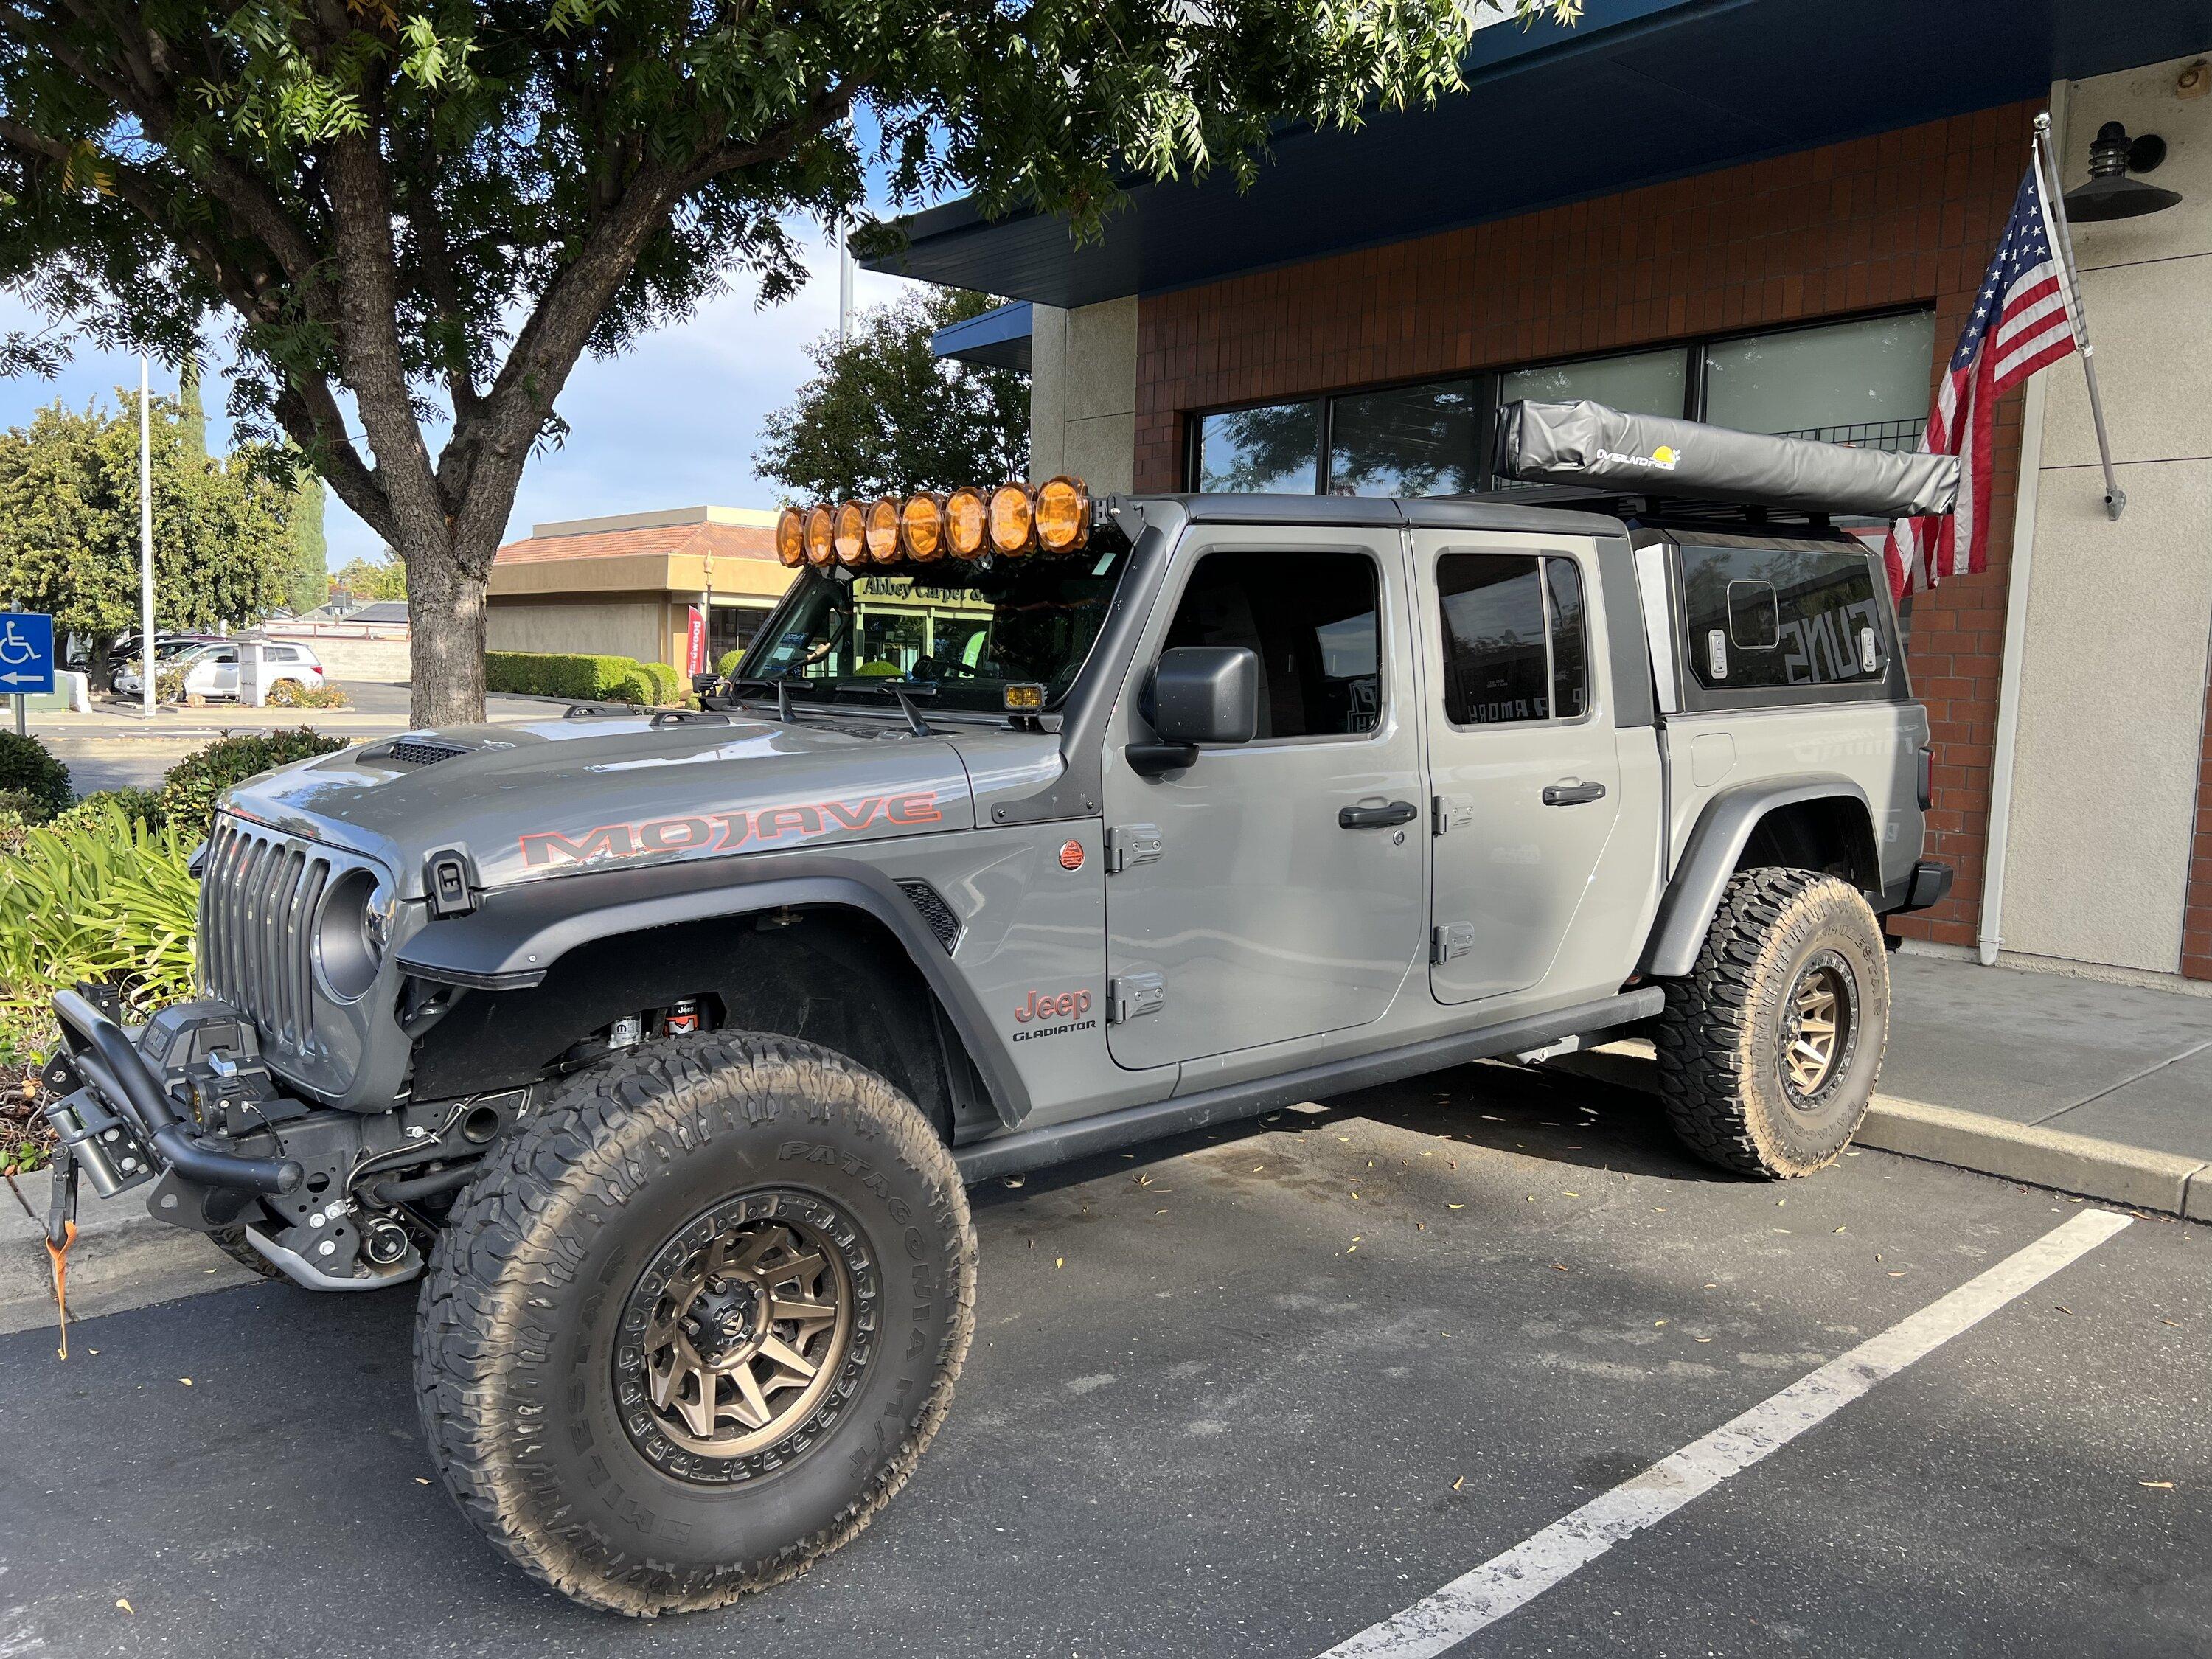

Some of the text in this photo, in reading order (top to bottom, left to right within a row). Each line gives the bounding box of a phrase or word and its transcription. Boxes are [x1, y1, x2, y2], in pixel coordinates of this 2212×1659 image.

[863, 577, 911, 600] Abbey
[687, 621, 701, 679] Hardwood
[519, 792, 942, 868] MOJAVE
[1015, 990, 1091, 1023] Jeep
[1012, 1020, 1096, 1042] GLADIATOR
[777, 1141, 932, 1363] PATAGONIA
